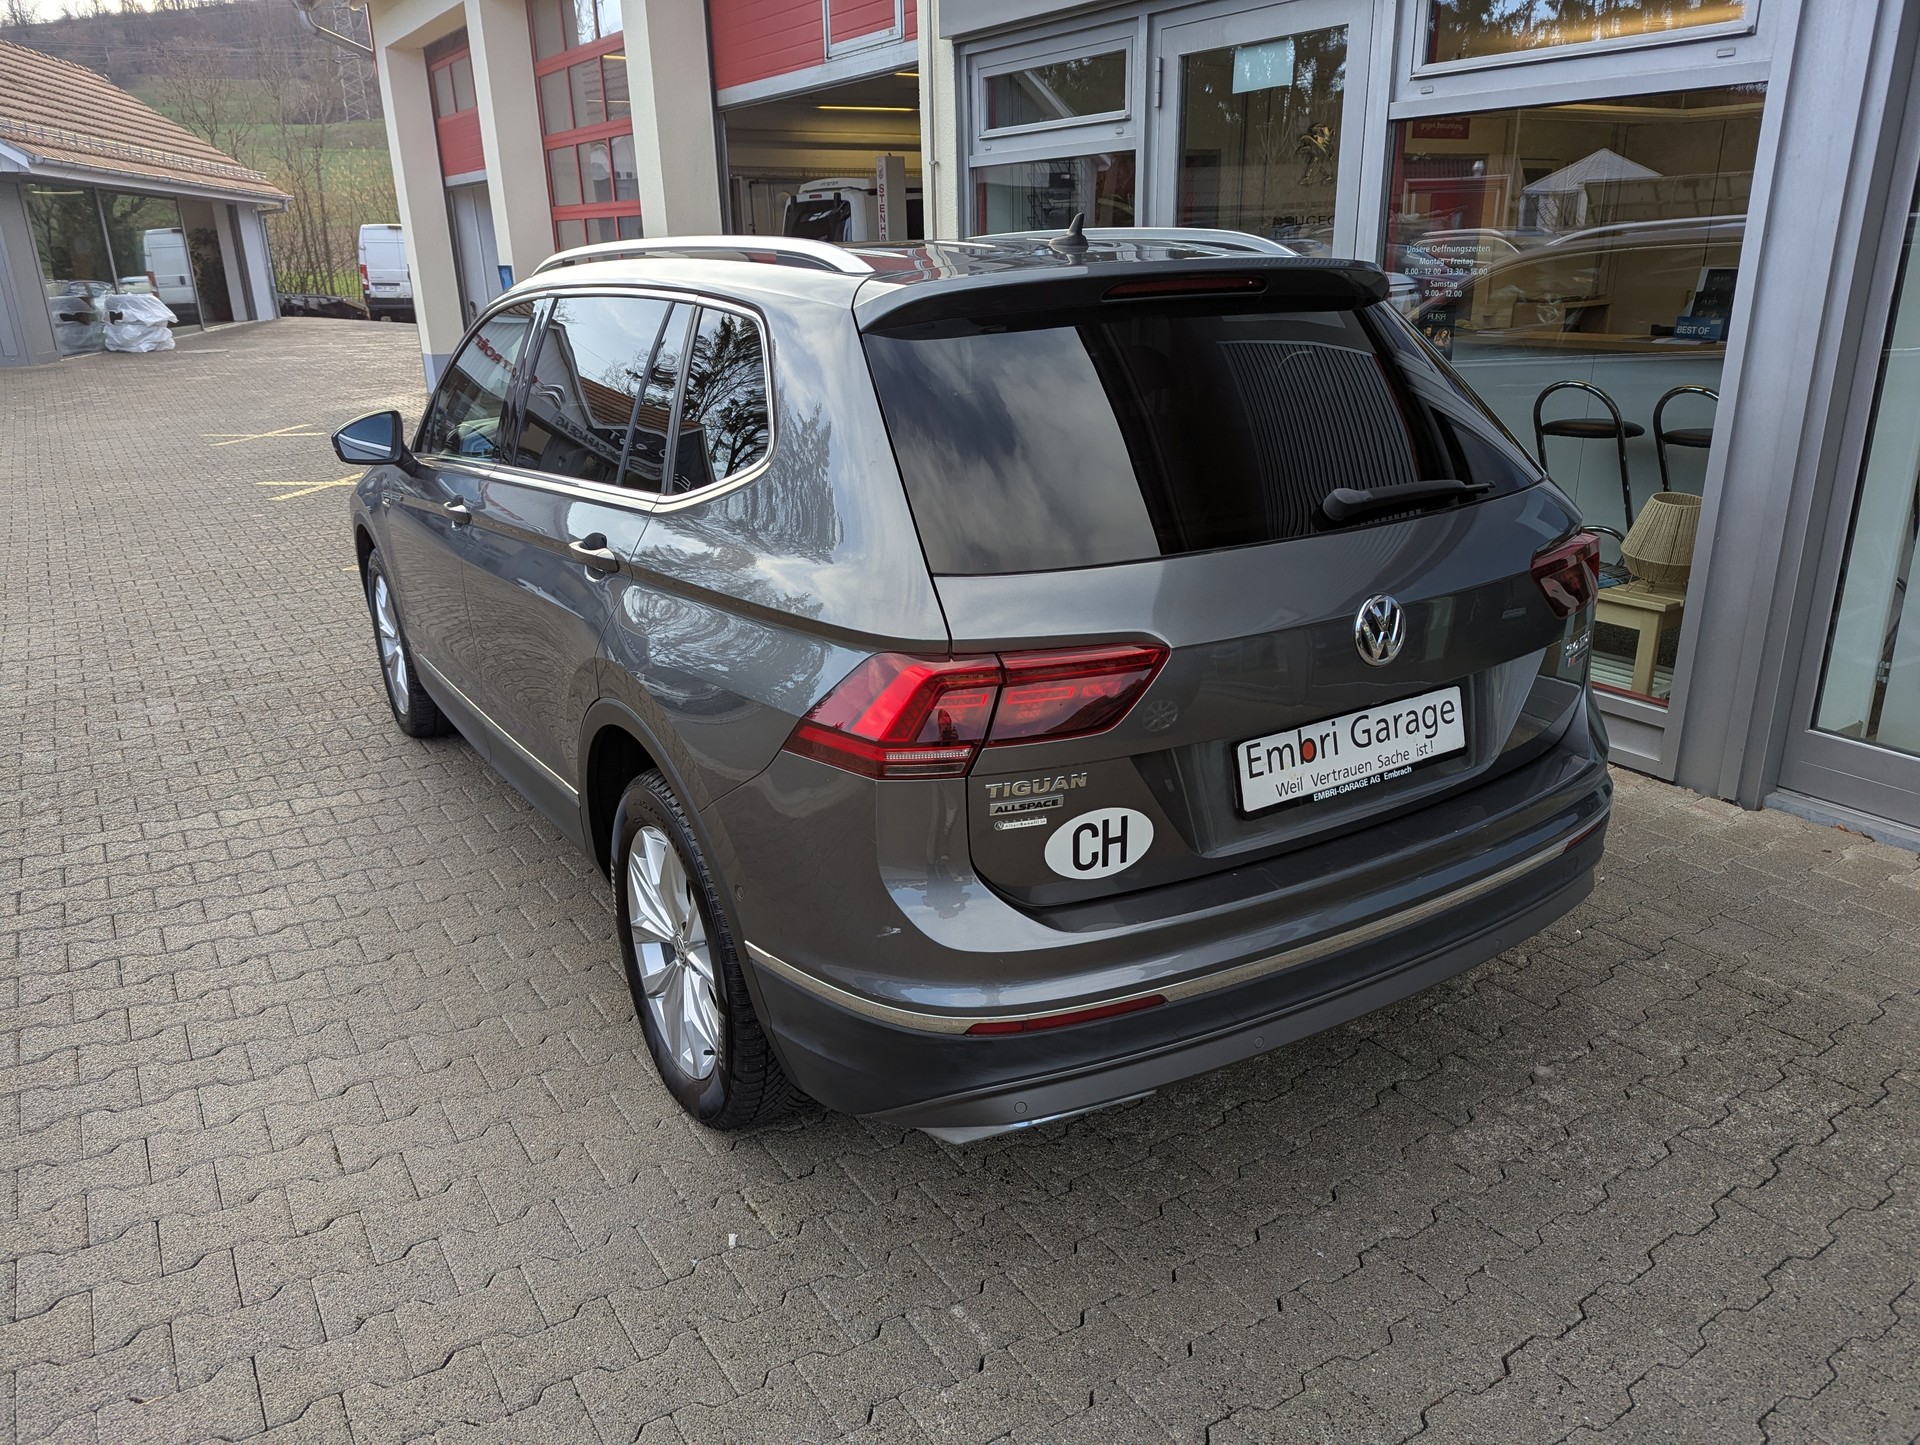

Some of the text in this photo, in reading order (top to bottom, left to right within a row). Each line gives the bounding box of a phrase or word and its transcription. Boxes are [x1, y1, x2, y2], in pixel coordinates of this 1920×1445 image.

[1406, 244, 1491, 254] Unsere Oeffnungszeiten
[1419, 257, 1445, 266] Montag
[1450, 257, 1474, 266] Freitag
[1404, 267, 1419, 275] 8.00
[1446, 267, 1464, 275] 13.30
[1470, 267, 1488, 276] 18.00
[1430, 280, 1458, 289] Samstag
[1424, 289, 1439, 297] 9.00
[1445, 290, 1463, 298] 12.00
[1676, 325, 1711, 335] BEST OF
[1246, 699, 1456, 779] Embri Garage
[1275, 777, 1304, 798] Weil
[1310, 757, 1373, 788] Vertrauen
[1377, 750, 1410, 769] Sache
[985, 772, 1088, 799] TIGUAN
[1313, 765, 1413, 802] EMBRI-GARAGE AG Embrach
[994, 798, 1060, 814] ALLSPACE
[1072, 815, 1129, 872] CH
